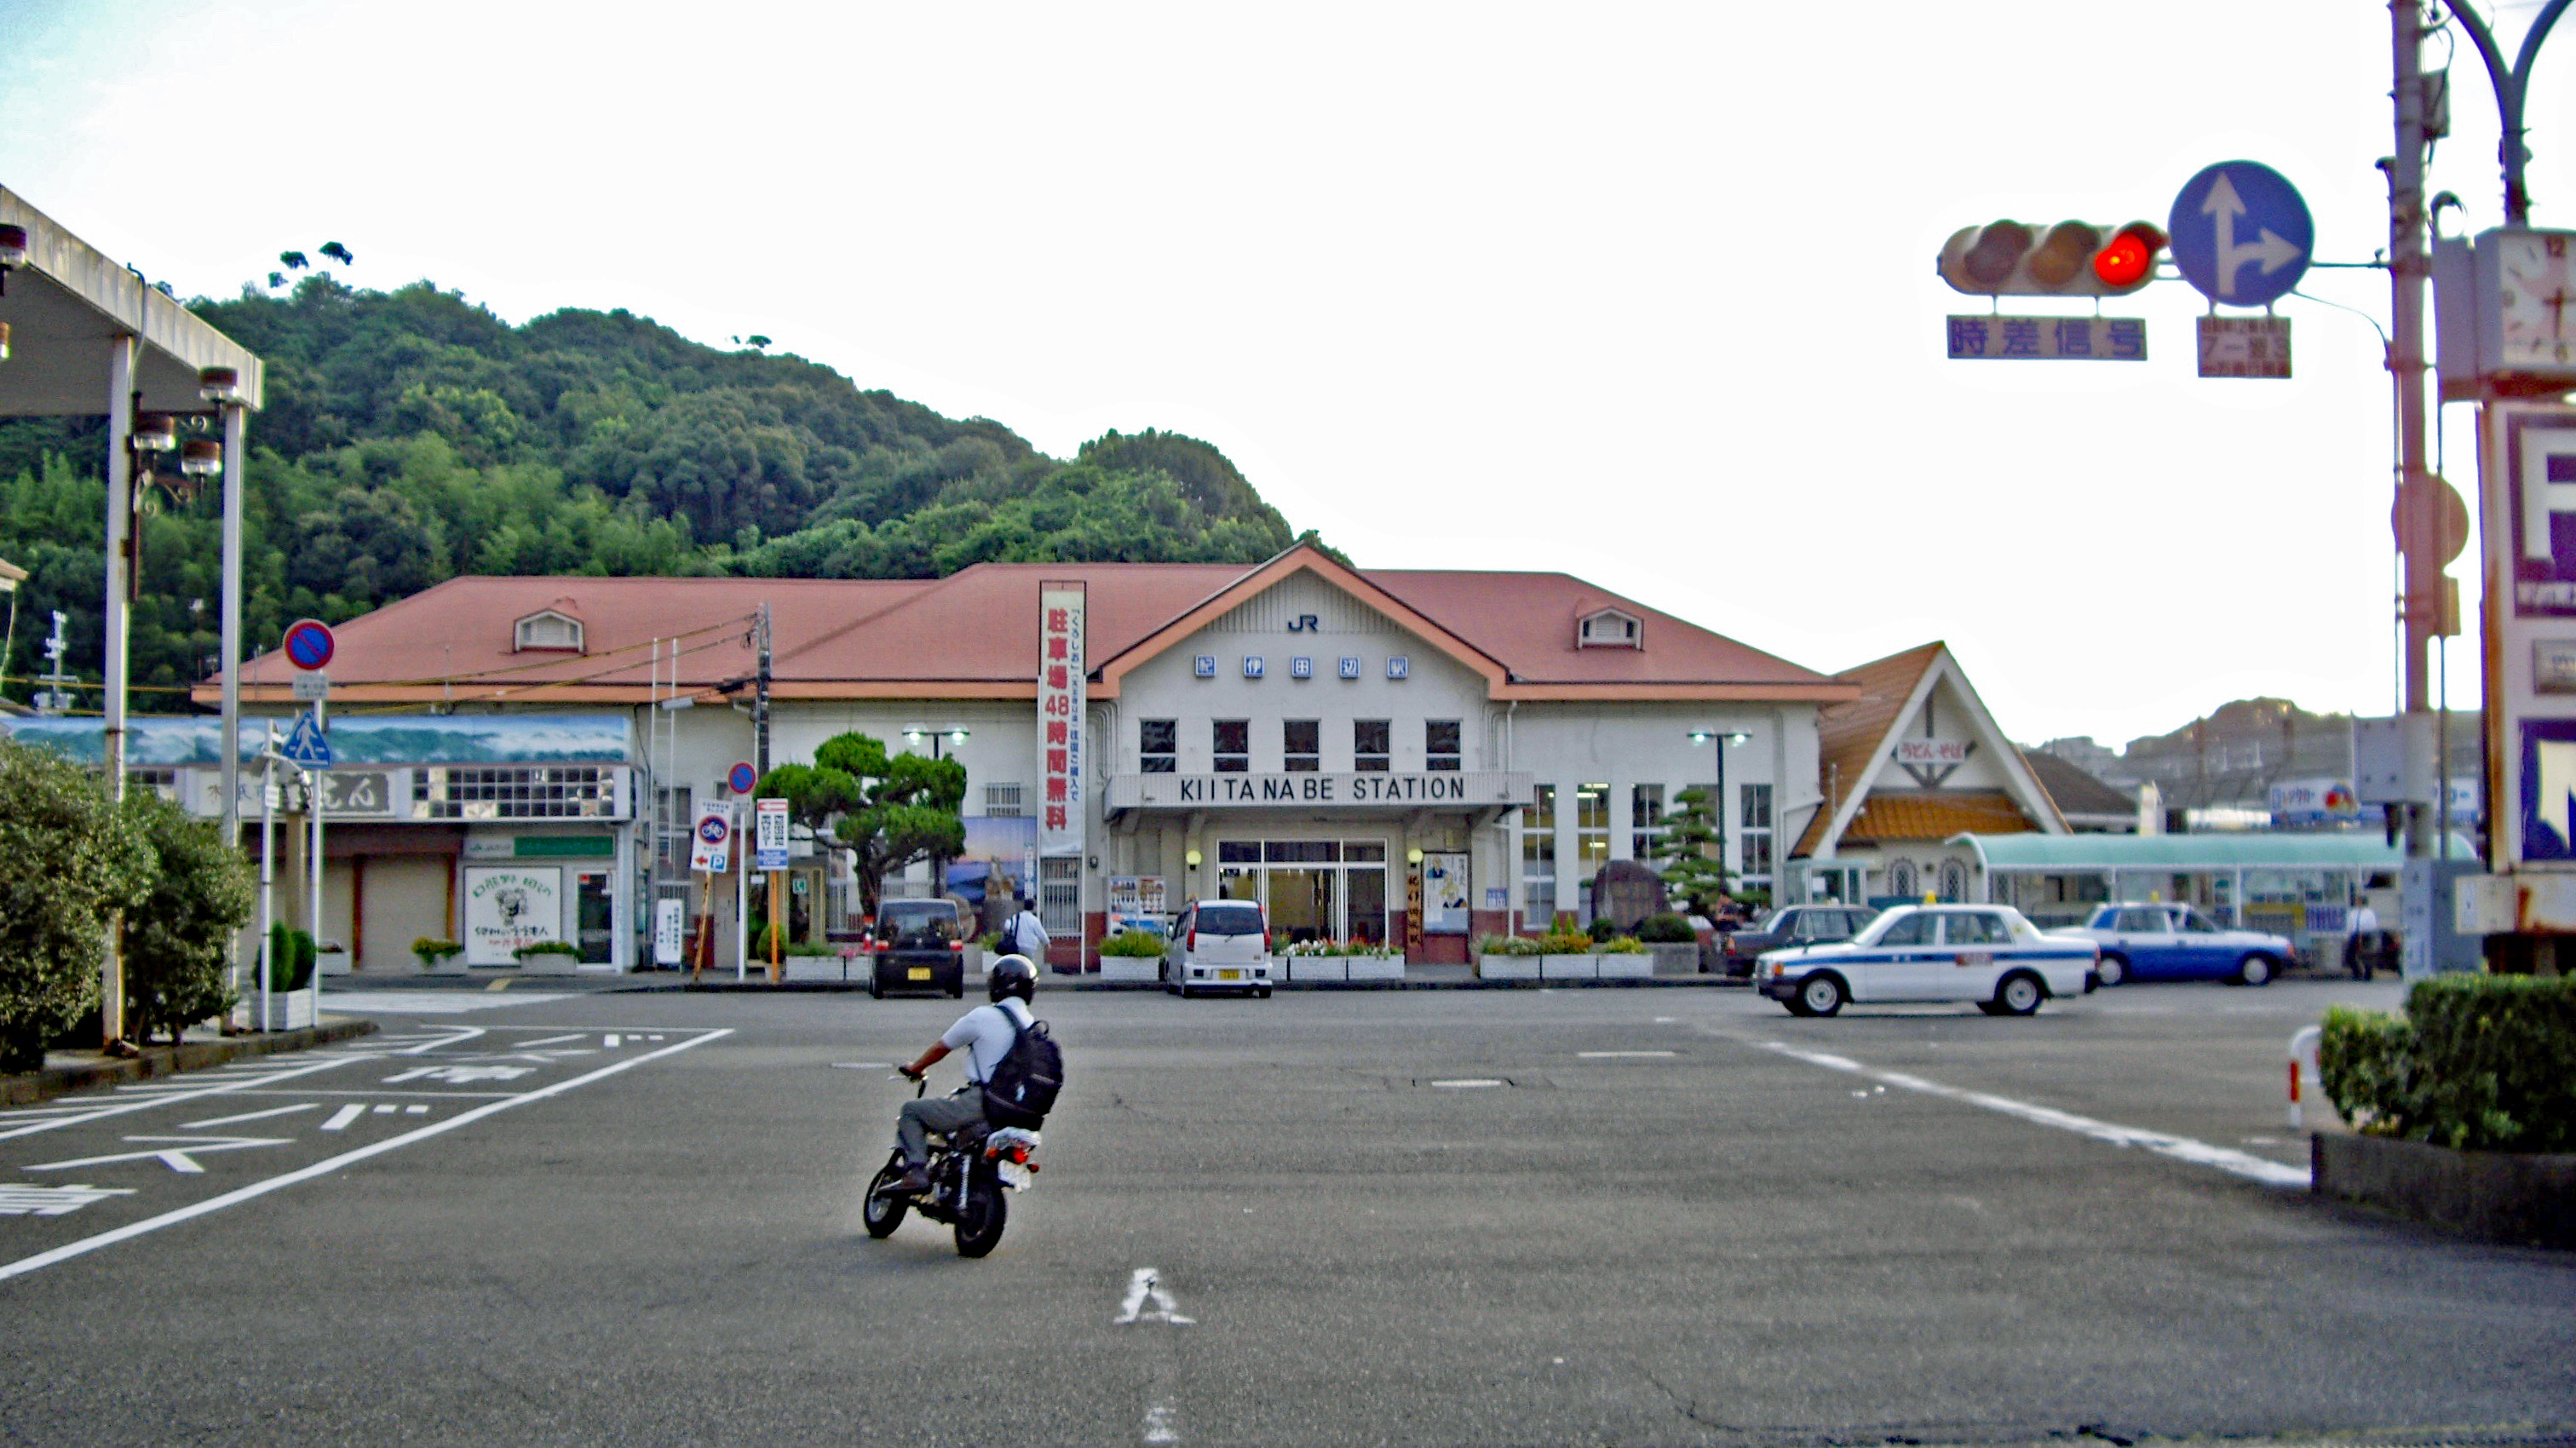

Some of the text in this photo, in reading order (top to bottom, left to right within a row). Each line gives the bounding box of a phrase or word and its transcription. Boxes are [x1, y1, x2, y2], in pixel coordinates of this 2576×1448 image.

[1951, 319, 2145, 357] 時差信号
[1288, 614, 1318, 632] JR
[1196, 655, 1408, 677] 紀伊田辺駅
[1181, 777, 1464, 801] KIITANABE STATION
